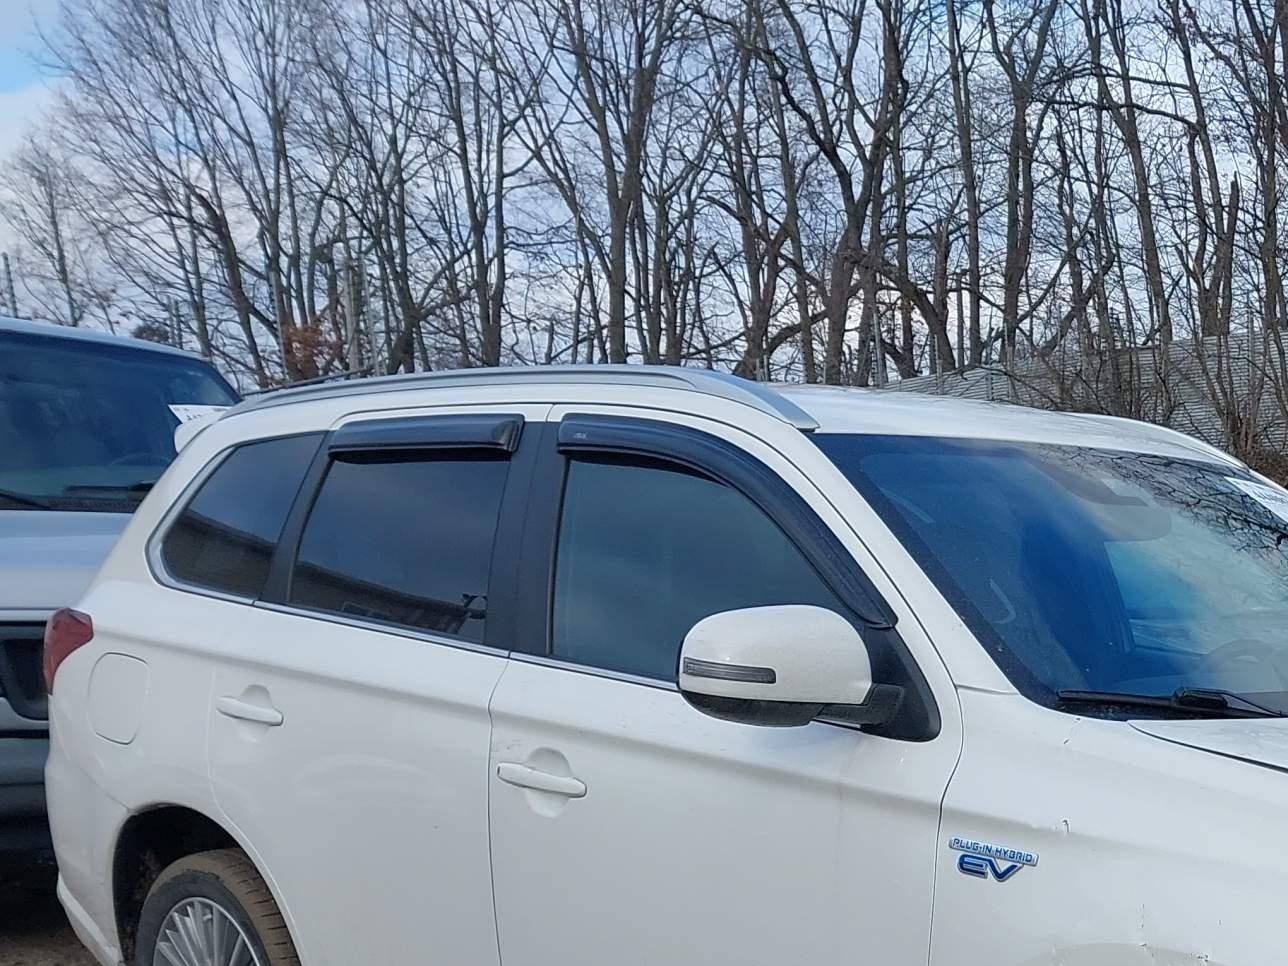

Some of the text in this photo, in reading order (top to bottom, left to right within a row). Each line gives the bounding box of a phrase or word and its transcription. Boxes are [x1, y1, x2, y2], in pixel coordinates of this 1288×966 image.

[953, 838, 1033, 863] PLUG-IN HYBRID
[958, 853, 1022, 881] EV
